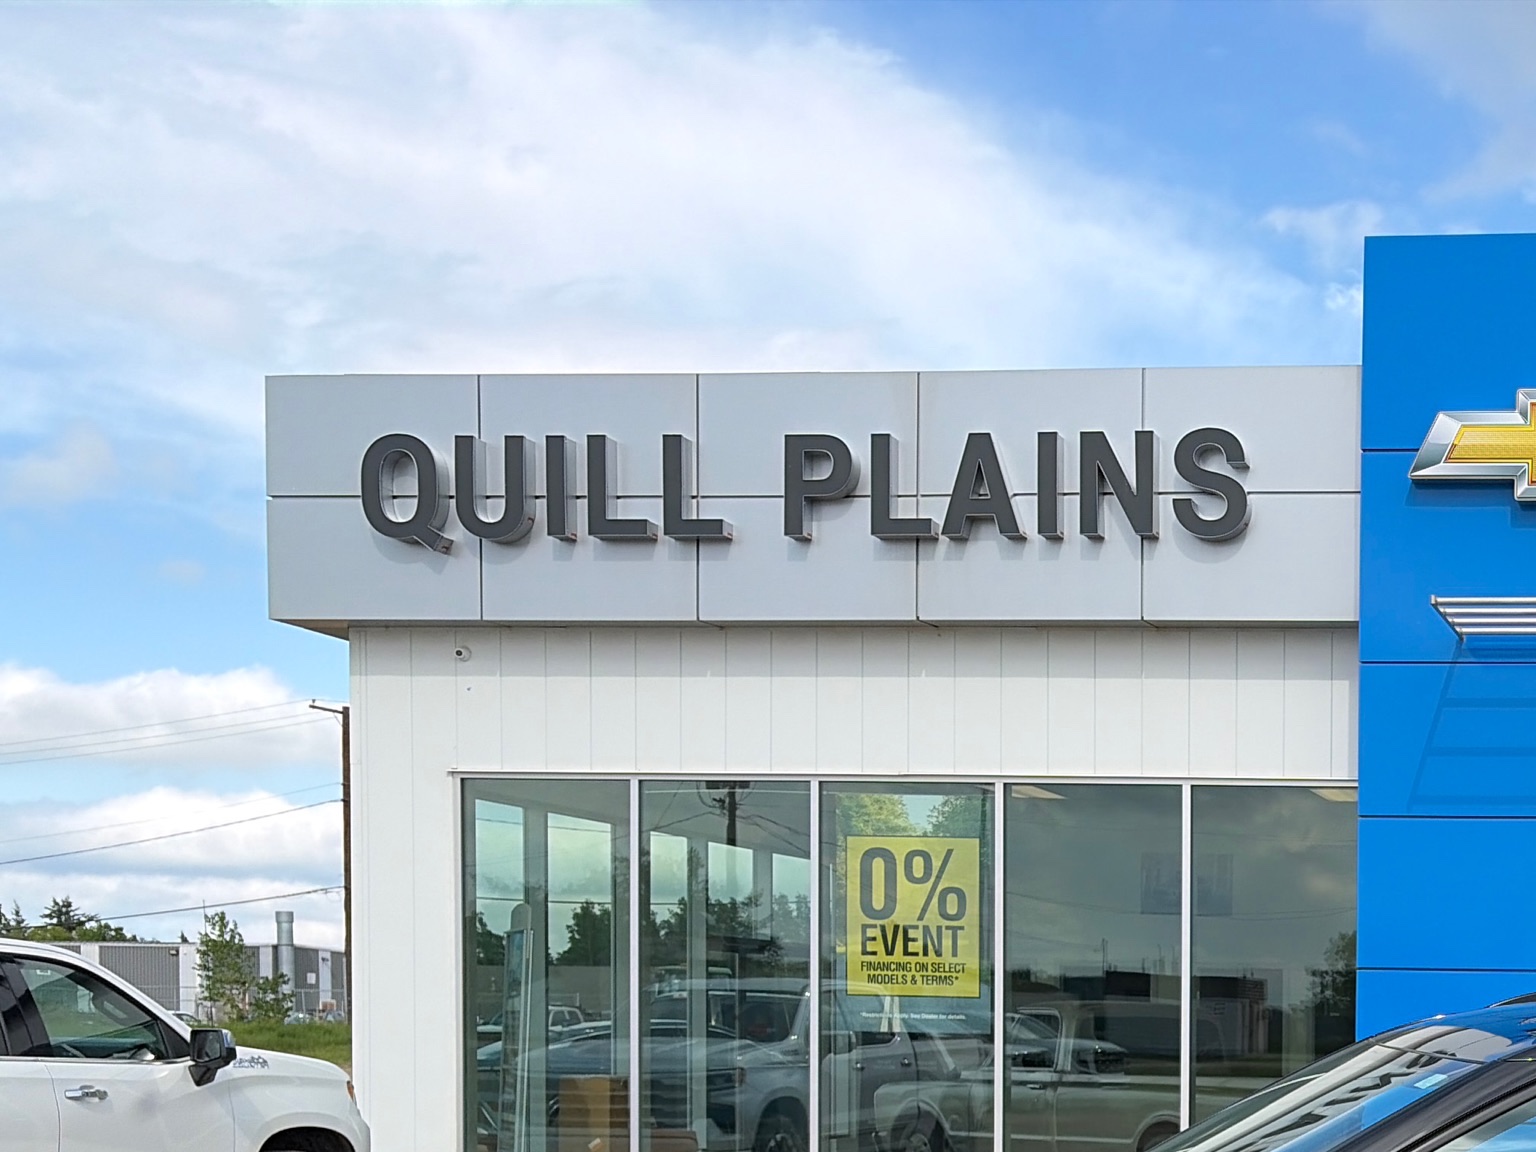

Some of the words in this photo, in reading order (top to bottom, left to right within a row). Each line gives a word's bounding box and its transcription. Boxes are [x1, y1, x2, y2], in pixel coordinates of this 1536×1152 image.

[361, 432, 733, 553] QUILL
[783, 427, 1250, 543] PLAINS
[859, 847, 967, 921] 0%
[861, 923, 965, 957] EVENT
[860, 961, 912, 973] FINANCING
[914, 962, 929, 973] ON
[931, 962, 966, 974] SELECT
[867, 973, 908, 985] MODELS
[910, 974, 918, 985] &
